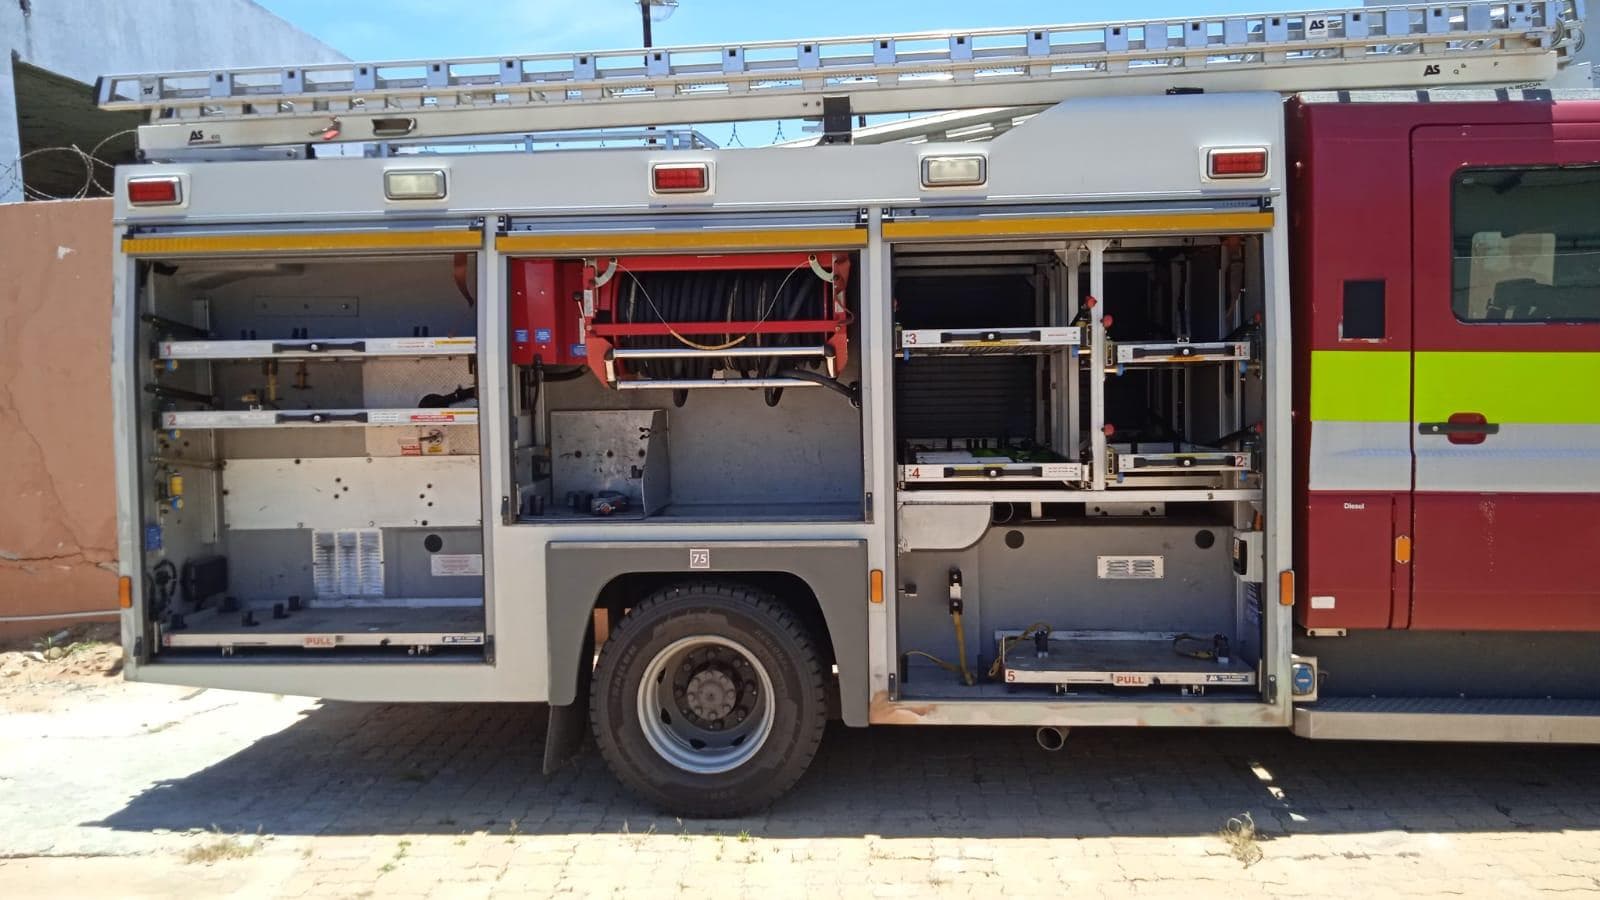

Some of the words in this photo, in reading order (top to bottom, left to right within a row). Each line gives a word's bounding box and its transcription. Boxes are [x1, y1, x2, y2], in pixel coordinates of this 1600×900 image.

[1423, 64, 1441, 76] AS
[909, 333, 917, 345] 3
[1236, 455, 1244, 467] 2
[912, 467, 921, 479] 4
[692, 553, 707, 564] 75
[305, 636, 333, 646] PULL
[1007, 670, 1016, 682] 5
[1115, 675, 1146, 684] PULL
